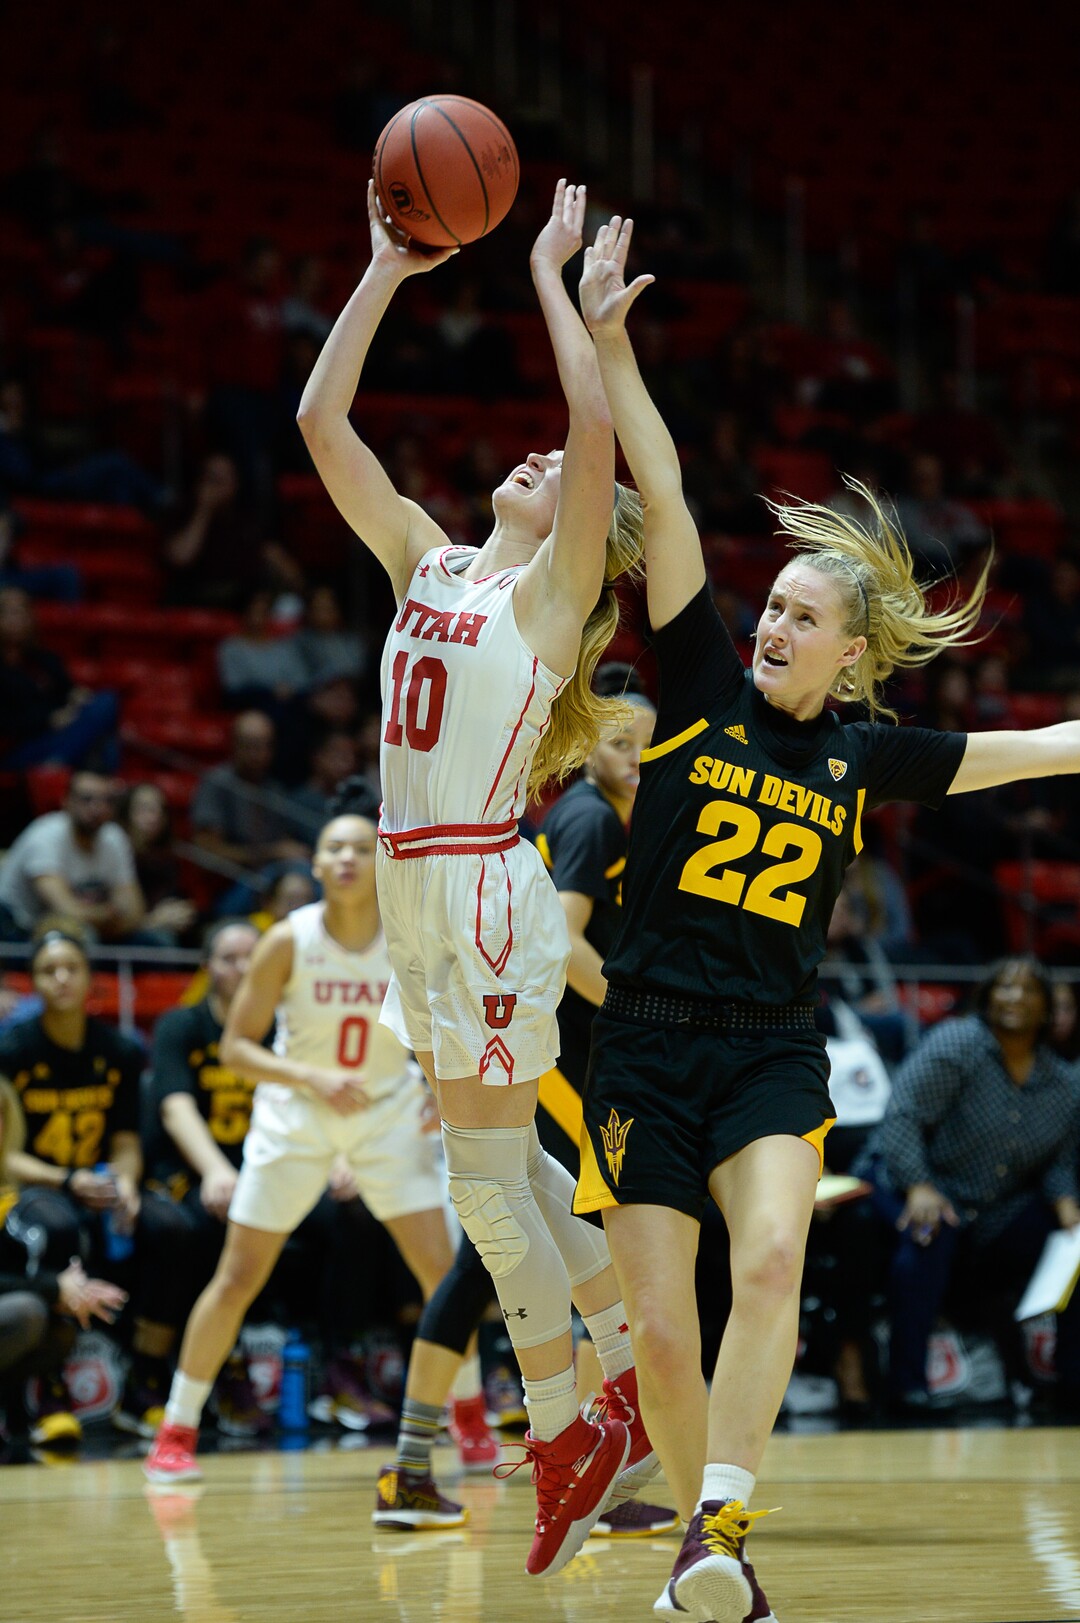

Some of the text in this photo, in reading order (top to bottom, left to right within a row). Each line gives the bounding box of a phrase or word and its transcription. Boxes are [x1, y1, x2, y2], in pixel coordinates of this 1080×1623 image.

[396, 598, 488, 648] UTAH
[384, 650, 448, 752] 10
[688, 755, 847, 836] SUN DEVILS
[677, 799, 823, 928] 22
[482, 993, 517, 1030] U
[338, 1014, 369, 1068] 0
[34, 1111, 106, 1167] 42
